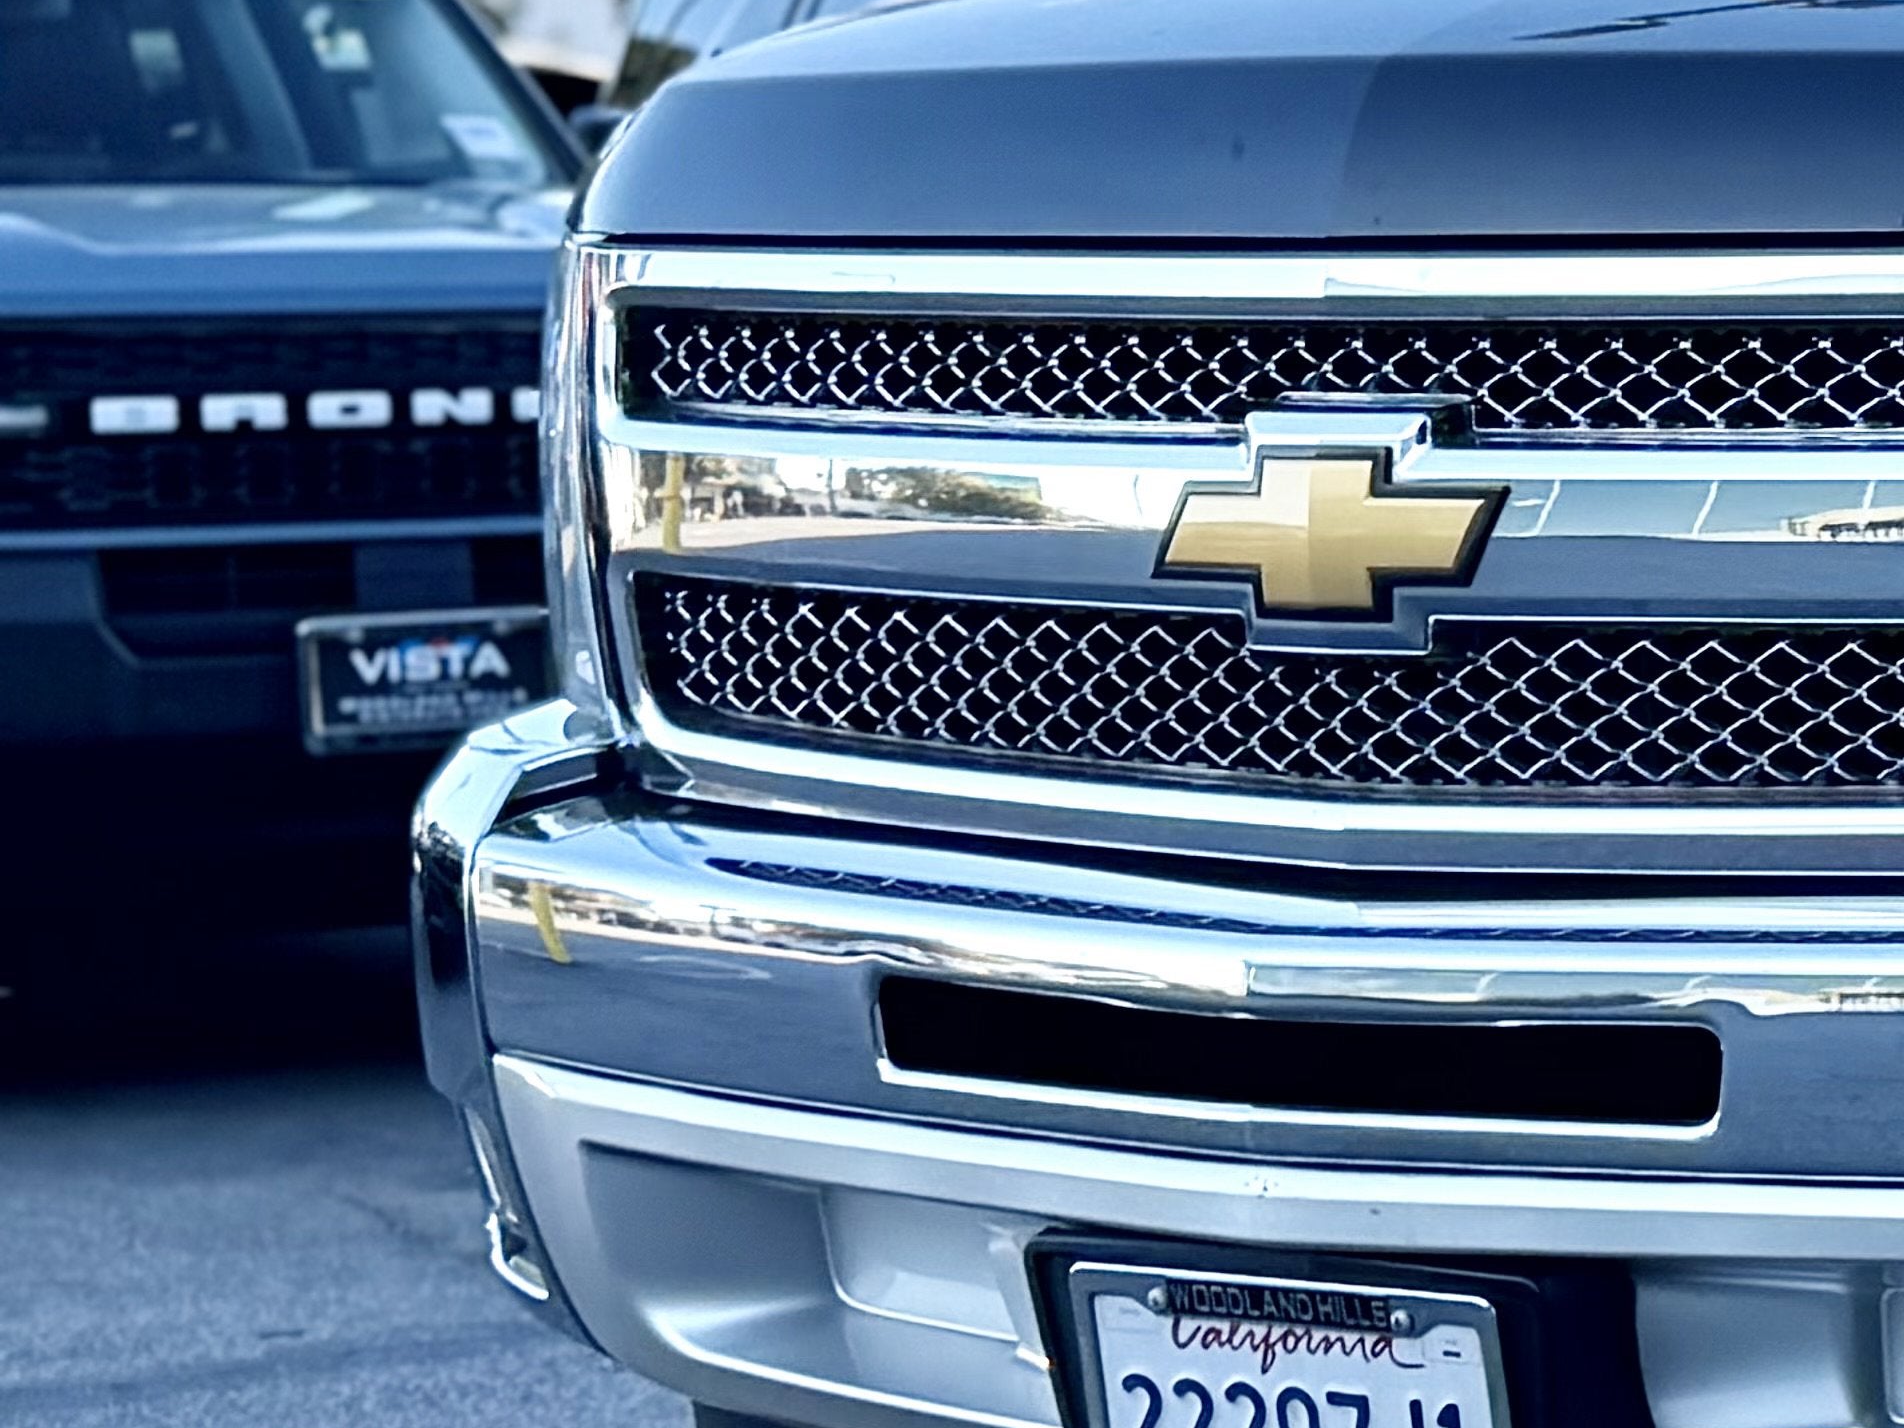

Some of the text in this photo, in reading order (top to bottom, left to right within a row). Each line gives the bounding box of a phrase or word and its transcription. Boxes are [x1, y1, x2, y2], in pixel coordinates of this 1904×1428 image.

[349, 640, 511, 685] VISTA
[1168, 1283, 1389, 1329] WOODLAND HILLS
[1172, 1316, 1426, 1375] California
